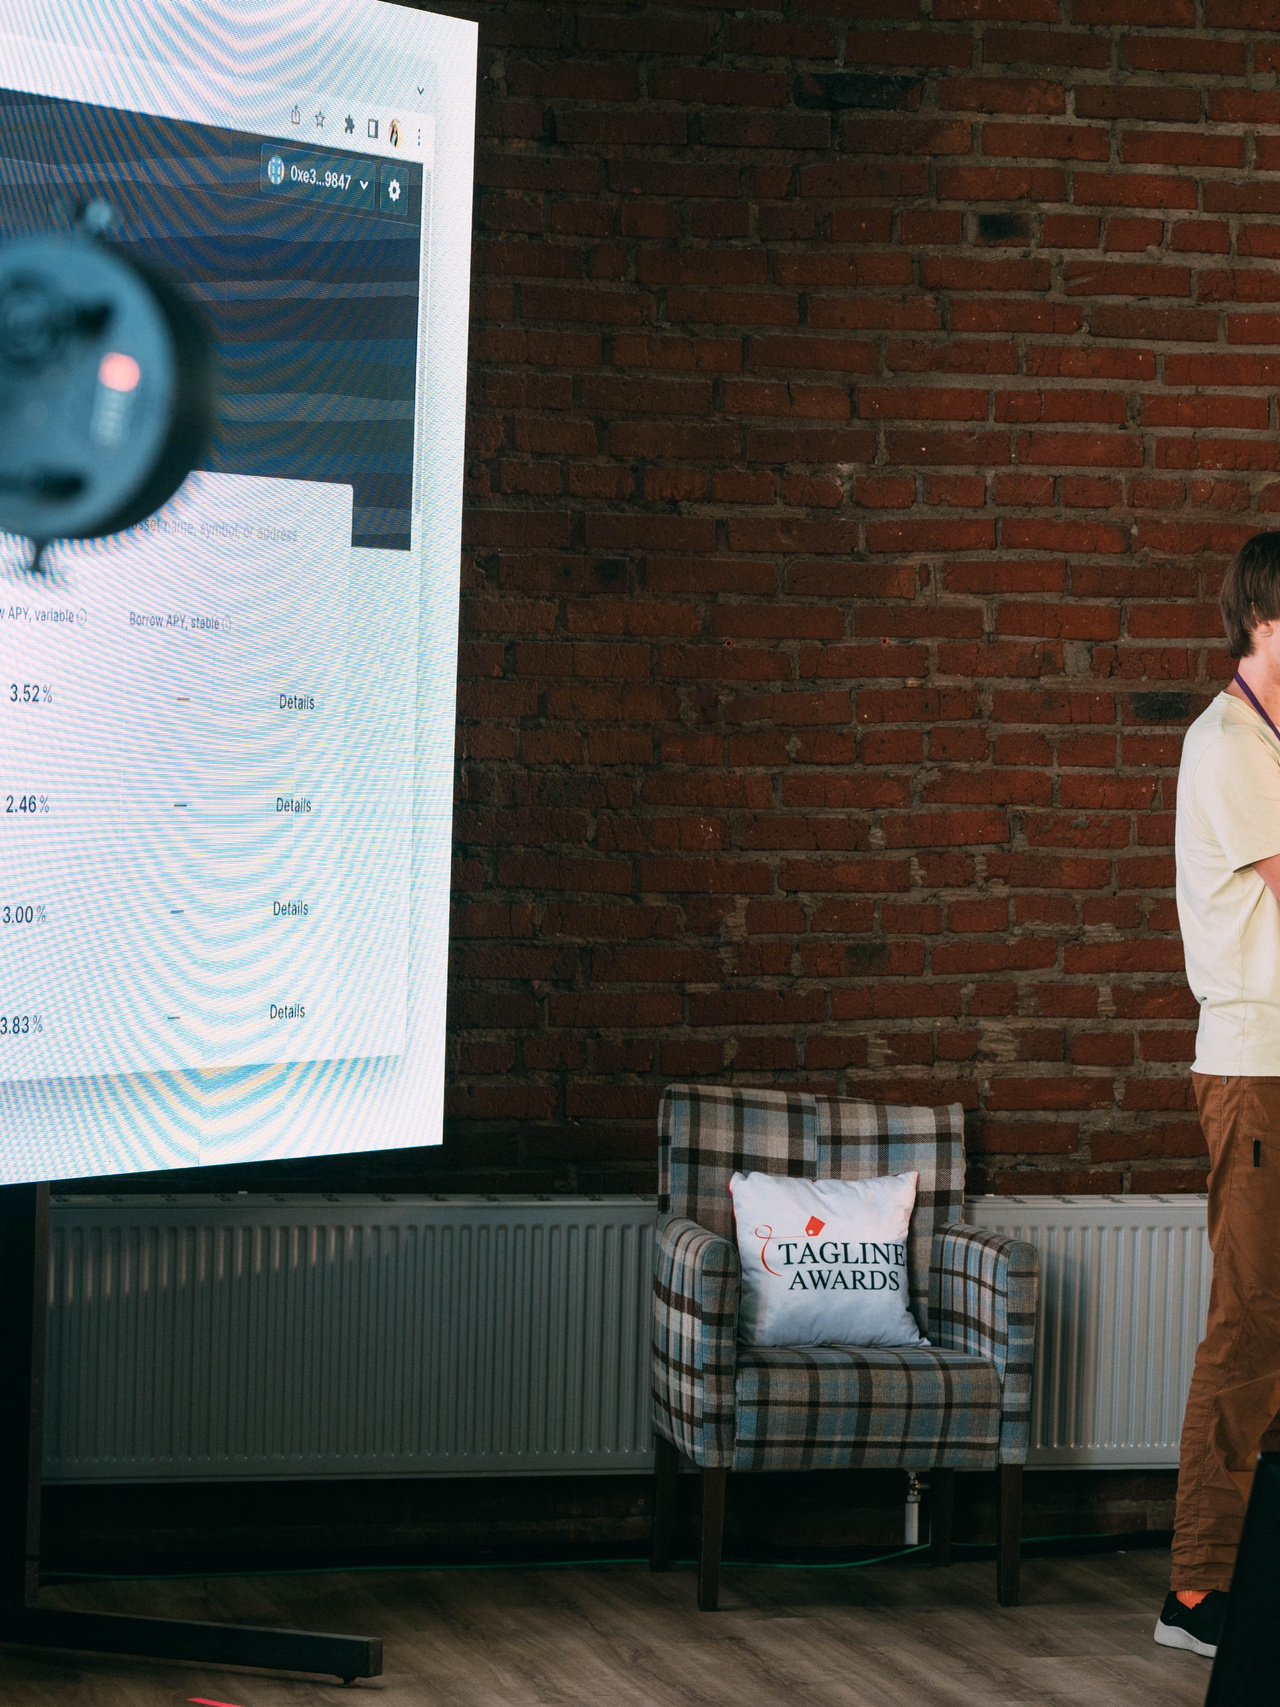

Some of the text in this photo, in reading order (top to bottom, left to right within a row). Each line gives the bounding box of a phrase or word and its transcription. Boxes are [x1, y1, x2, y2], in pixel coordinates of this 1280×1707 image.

[290, 165, 351, 190] 0xe3...9847
[8, 607, 32, 623] APY,
[34, 609, 74, 623] variable
[129, 612, 220, 631] Borrow APY, stable
[279, 694, 315, 710] Details
[276, 798, 312, 813] Details
[273, 901, 309, 916] Details
[270, 1003, 306, 1019] Details
[778, 1241, 906, 1267] TAGLINE
[788, 1270, 900, 1291] AWARDS
